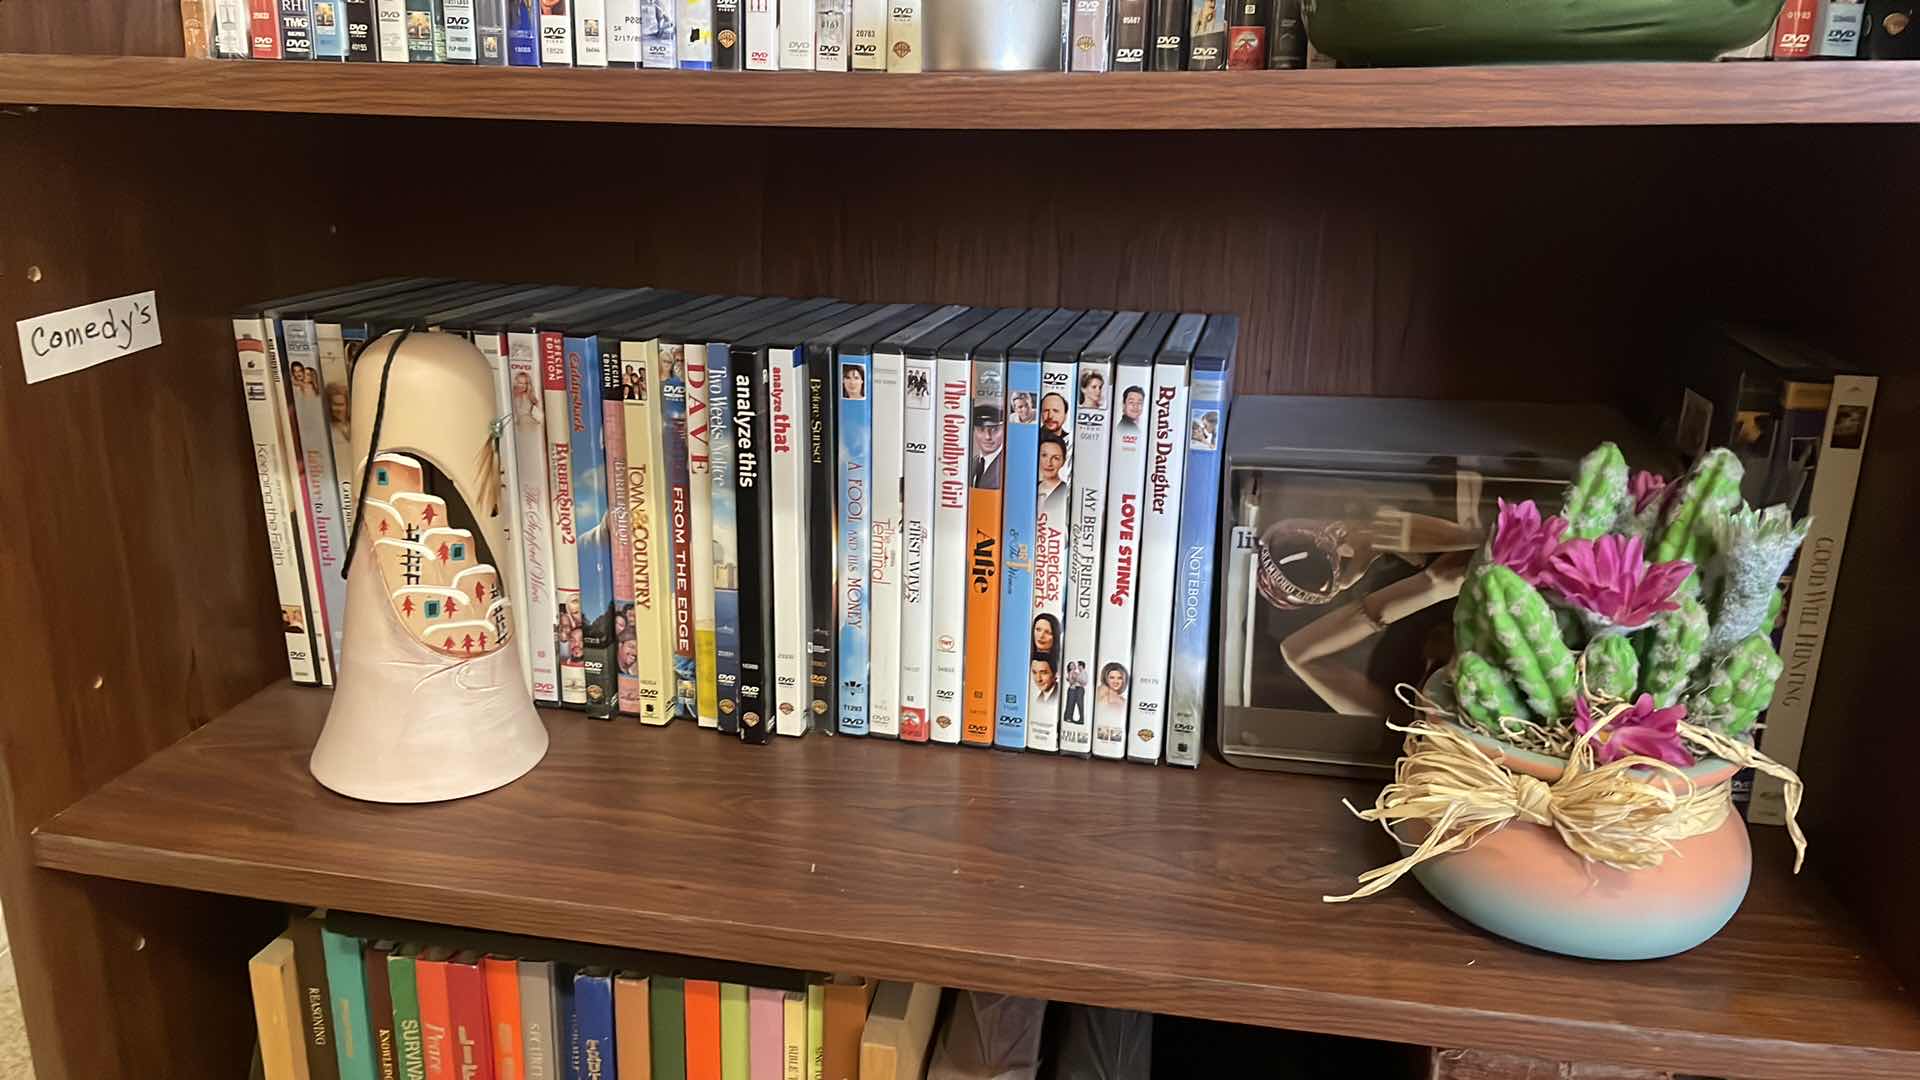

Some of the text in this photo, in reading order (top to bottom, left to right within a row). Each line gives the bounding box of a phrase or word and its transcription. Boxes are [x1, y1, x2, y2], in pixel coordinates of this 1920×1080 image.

[284, 18, 309, 28] TMG
[349, 23, 369, 31] DVD
[446, 16, 470, 25] DVD
[543, 26, 567, 35] DVD
[1780, 33, 1811, 43] DVD
[1826, 29, 1856, 38] DVD
[819, 44, 841, 52] DVD
[854, 44, 877, 52] DVD
[1116, 48, 1144, 58] DVD
[1156, 36, 1181, 44] DVD
[1192, 47, 1218, 56] DVD
[31, 303, 151, 356] Comedy's
[545, 337, 556, 381] EDITION
[554, 337, 562, 381] SPECIAL
[602, 353, 611, 388] EDITION
[611, 353, 619, 388] SPECIAL
[1043, 372, 1069, 381] DVD
[663, 385, 686, 393] DVD
[709, 366, 728, 395] Two
[687, 364, 710, 474] DAVE
[710, 396, 729, 441] Weeks
[770, 366, 791, 454] analyze that
[809, 378, 823, 464] Before Sunset
[1078, 413, 1104, 421] DVD
[733, 375, 757, 488] analyze this
[906, 442, 926, 450] DVD
[938, 379, 968, 510] The Goodbye Girl
[847, 461, 863, 471] A
[1150, 386, 1176, 515] Ryan's Daughter
[628, 464, 646, 511] TOWN
[847, 479, 863, 523] FOOL
[672, 487, 685, 543] FROM
[871, 519, 892, 585] Terminal
[908, 519, 921, 555] FIRST
[1077, 488, 1098, 620] MY BEST FRIEND'S
[1110, 493, 1136, 607] LOVE STINKS
[632, 527, 651, 611] COUNTRY
[676, 551, 689, 592] THE
[972, 528, 996, 594] Alfie
[1034, 512, 1048, 609] sweethearts
[1047, 527, 1063, 602] America's
[847, 577, 863, 631] MONEY
[1182, 546, 1203, 632] NOTEBOOK
[677, 598, 689, 651] EDGE
[1783, 536, 1835, 706] GOOD WILL HUNTING
[584, 661, 603, 670] DVD
[717, 673, 736, 682] DVD
[778, 676, 796, 684] DVD
[640, 688, 659, 696] DVD
[741, 685, 759, 694] DVD
[936, 689, 955, 697] DVD
[841, 717, 864, 726] DVD
[1000, 715, 1023, 724] DVD
[308, 987, 327, 1045] REASONING
